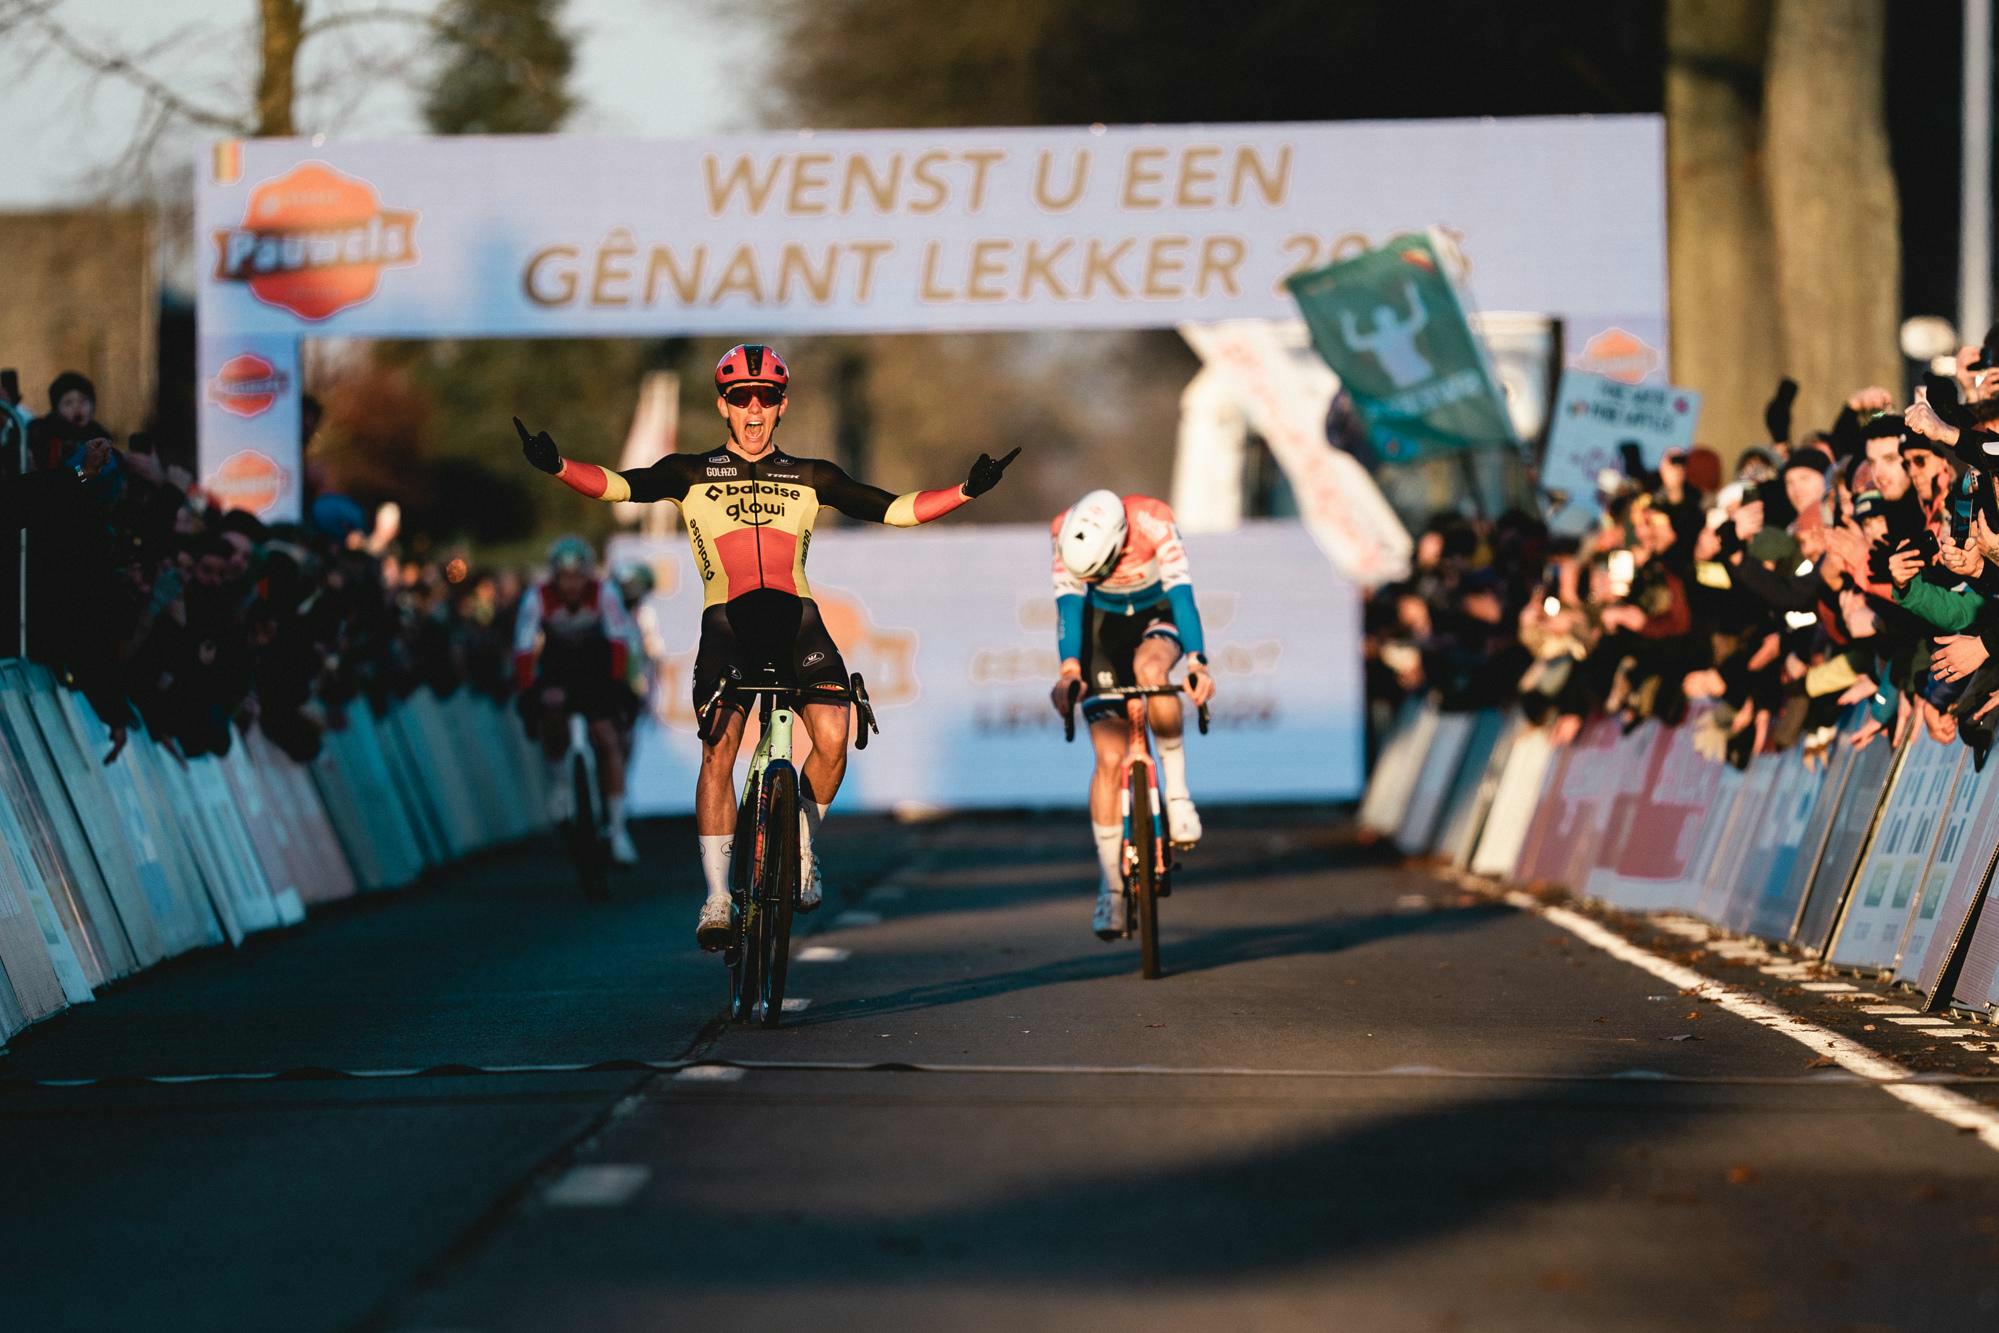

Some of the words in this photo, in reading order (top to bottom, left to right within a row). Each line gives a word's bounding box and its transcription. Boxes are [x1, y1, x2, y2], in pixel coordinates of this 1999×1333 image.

[704, 150, 1007, 216] WENST
[1035, 148, 1092, 210] U
[1121, 144, 1294, 208] EEN
[521, 227, 895, 308] GÊNANT
[919, 235, 1248, 300] LEKKER
[706, 467, 738, 477] GOLAZO
[726, 482, 801, 500] baloise
[726, 498, 785, 522] glowi
[689, 518, 711, 572] baloise
